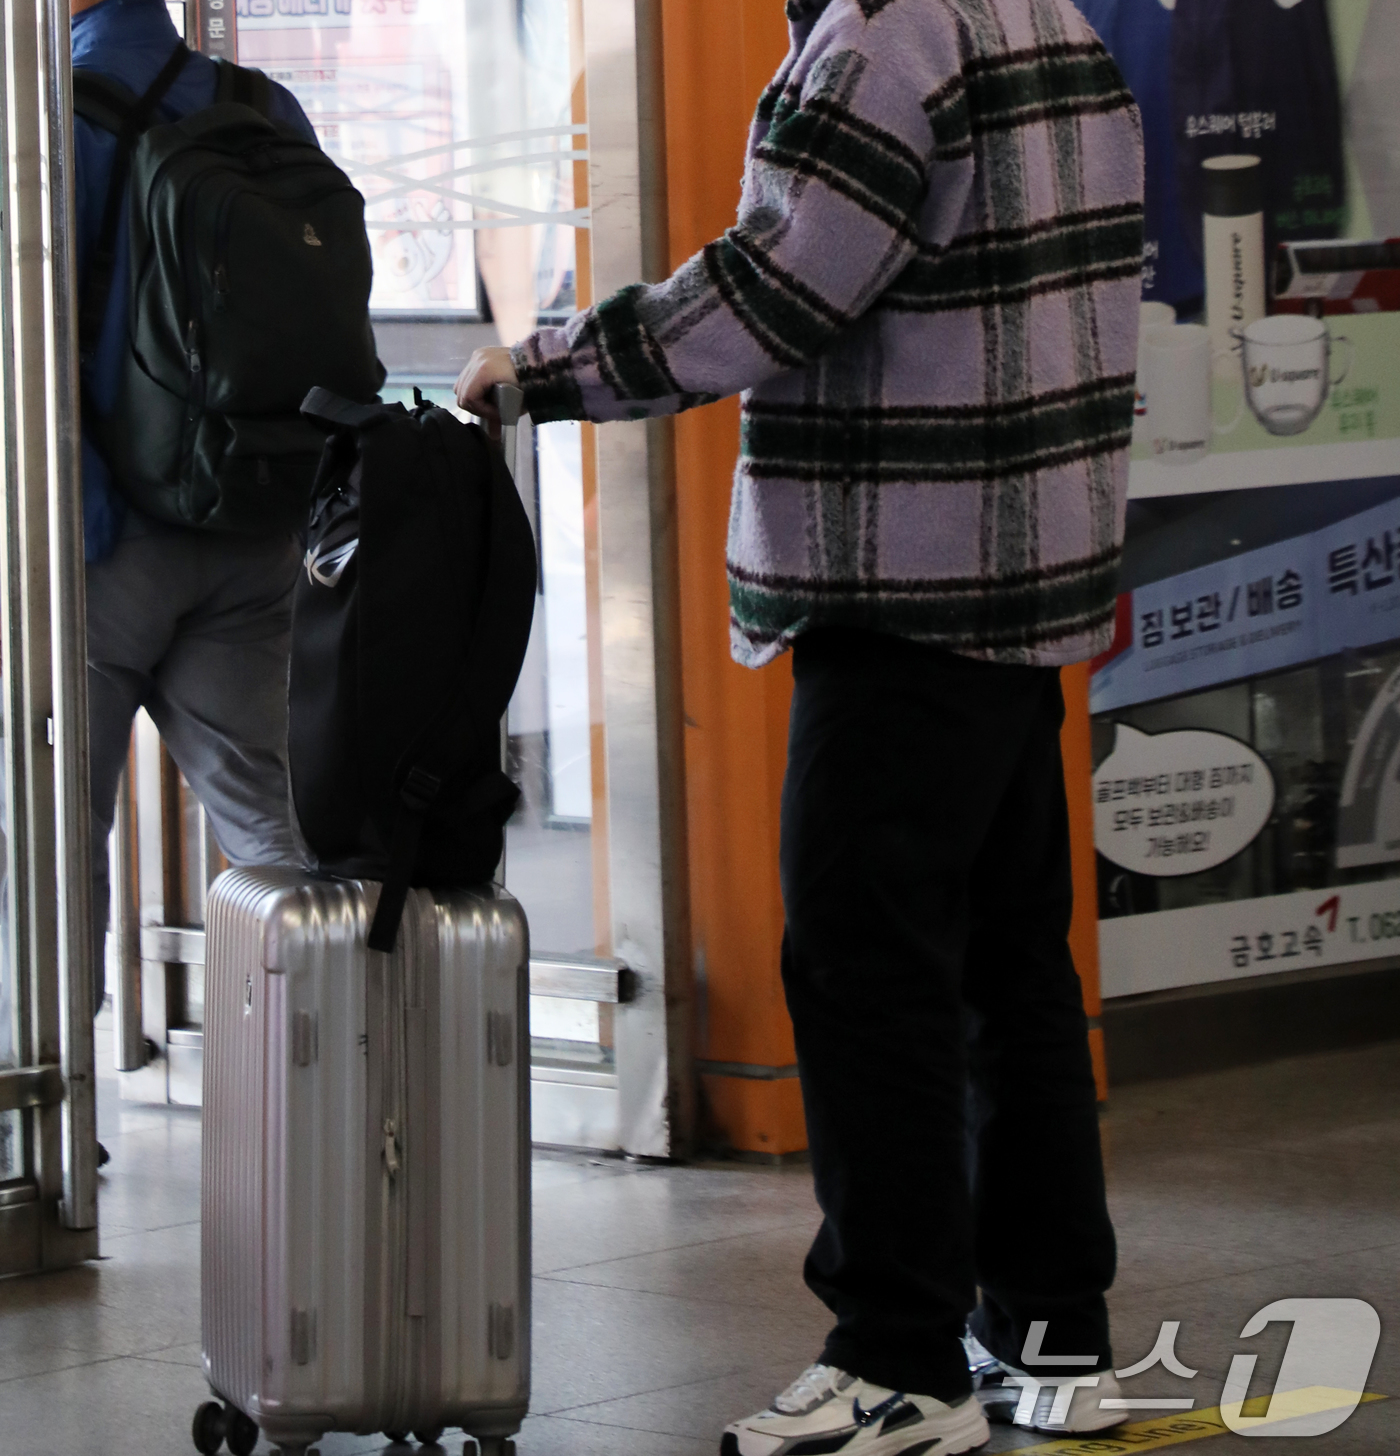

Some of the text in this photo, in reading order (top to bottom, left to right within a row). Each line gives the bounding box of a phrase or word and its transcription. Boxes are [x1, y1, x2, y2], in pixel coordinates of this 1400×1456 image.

[1247, 568, 1303, 617] 배송
[1328, 529, 1400, 597] 특산
[1113, 806, 1144, 832] 모두
[1229, 924, 1326, 968] 금호고속
